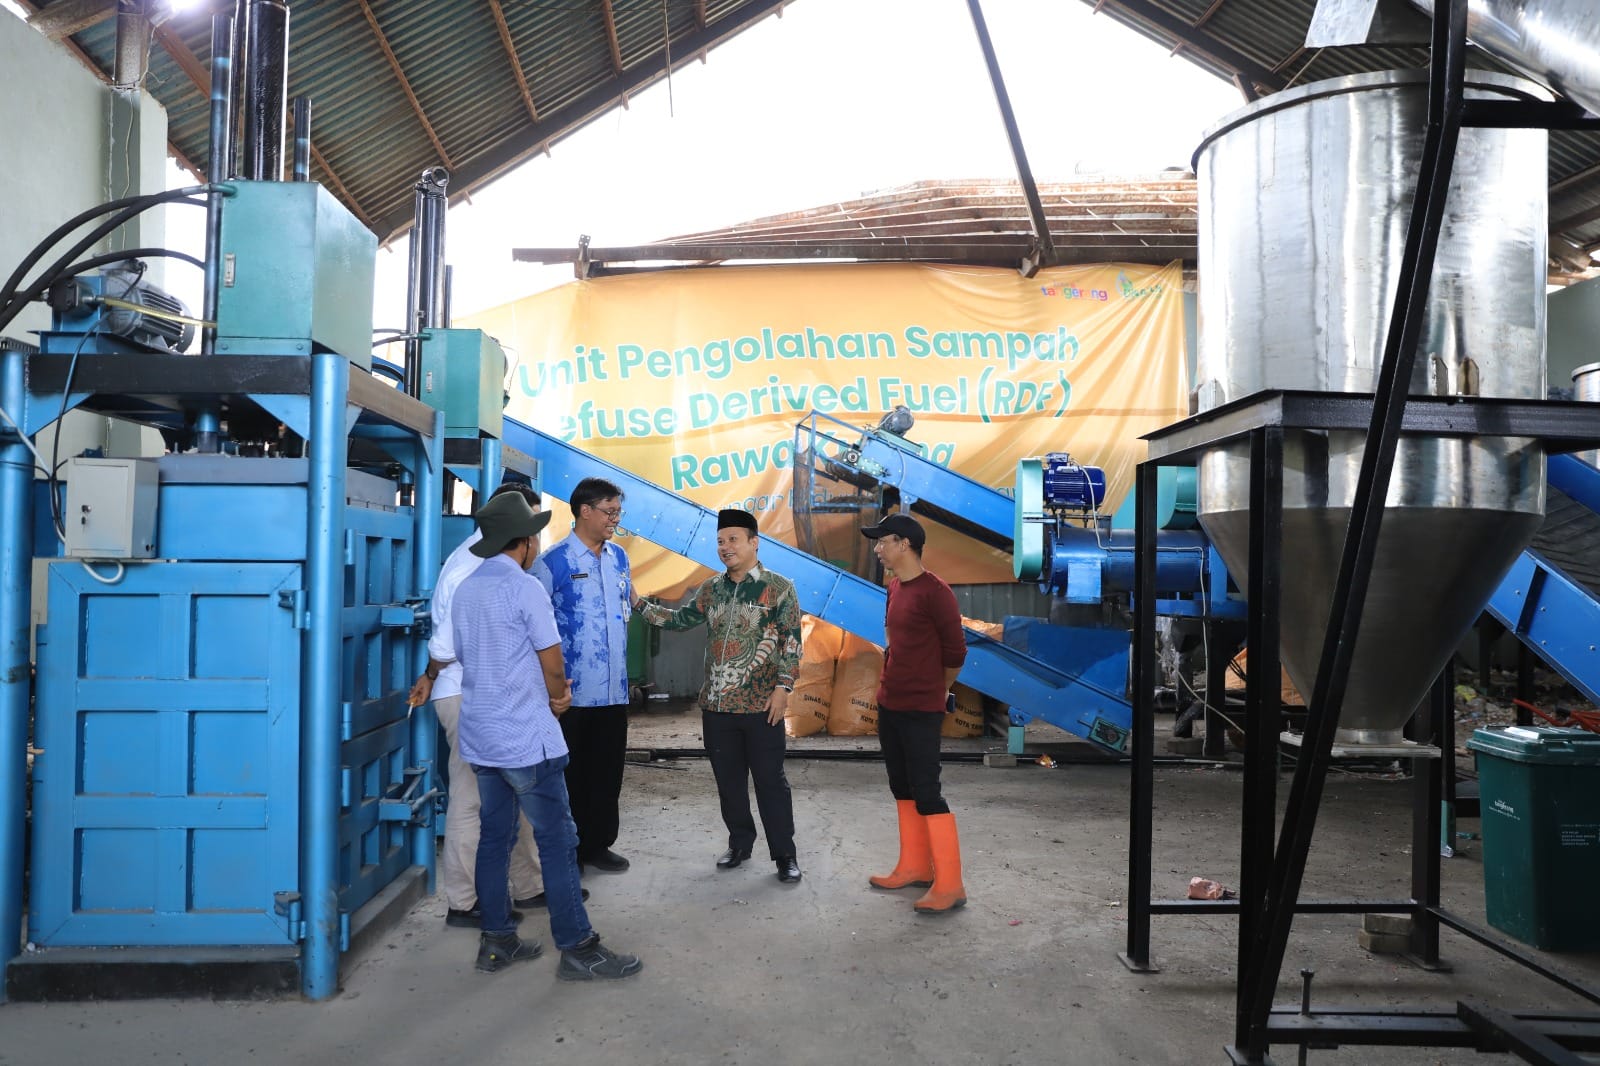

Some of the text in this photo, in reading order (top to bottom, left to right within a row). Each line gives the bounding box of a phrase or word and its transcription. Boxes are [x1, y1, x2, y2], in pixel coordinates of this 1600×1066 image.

[1040, 286, 1109, 302] tagerng
[518, 325, 1080, 398] Unit Pengolahan Sampah
[559, 366, 1072, 443] efuse Derived Fuel (RDF)
[671, 437, 798, 492] Rawa
